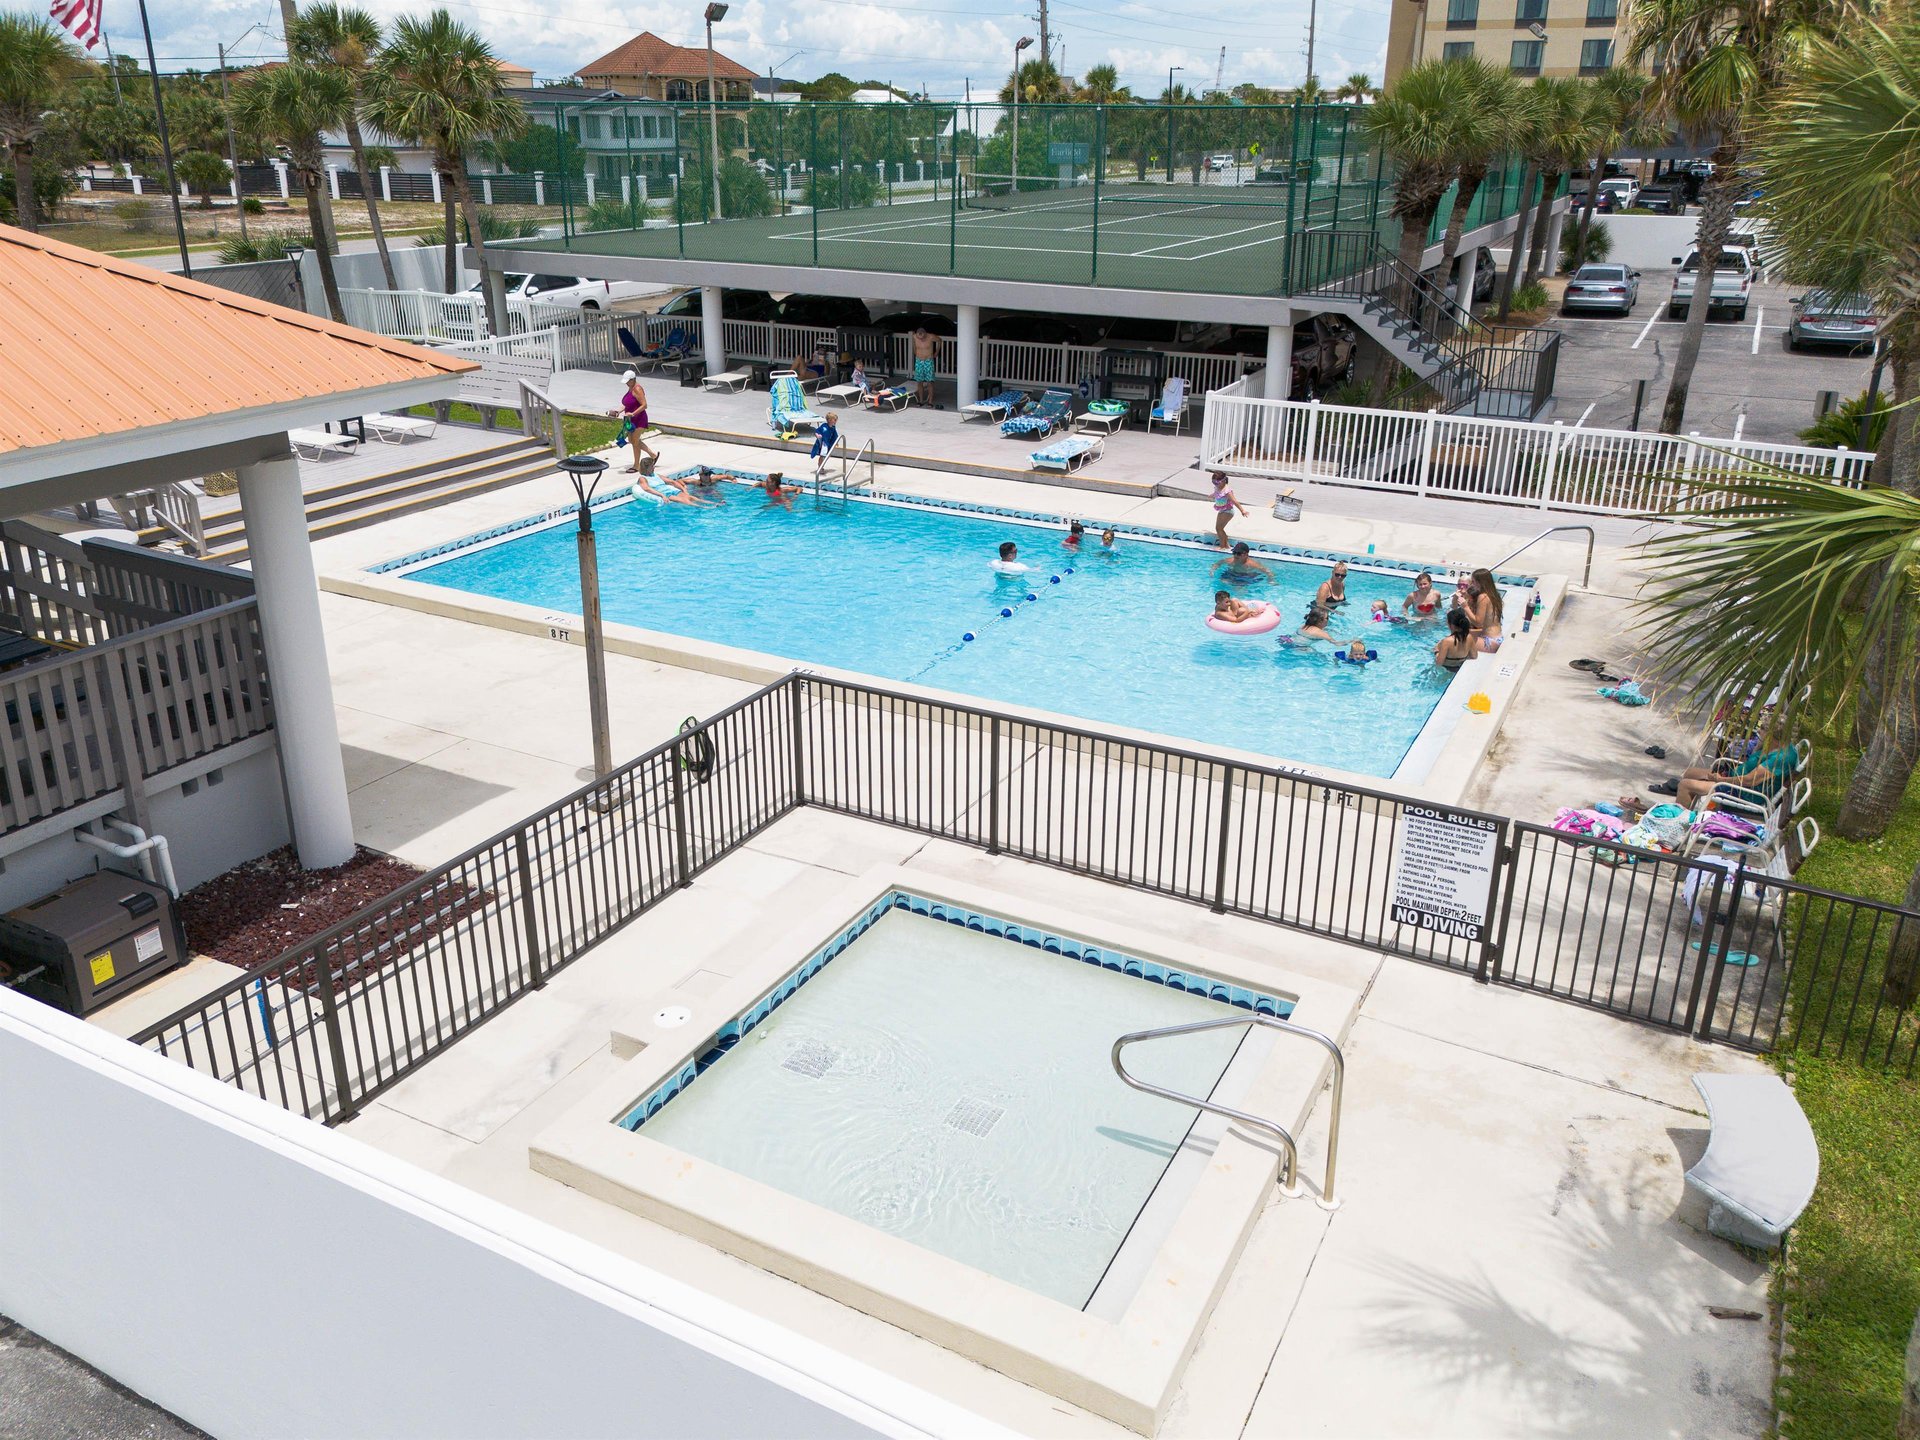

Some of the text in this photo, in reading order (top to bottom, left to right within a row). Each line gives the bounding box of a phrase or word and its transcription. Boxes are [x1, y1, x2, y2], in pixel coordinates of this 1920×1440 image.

[550, 628, 557, 639] 8
[1405, 804, 1496, 831] POOL RULES
[1395, 896, 1481, 923] POOL MAXIMUM DEPTH: 2 FEET
[1395, 906, 1478, 940] NO DIVING
